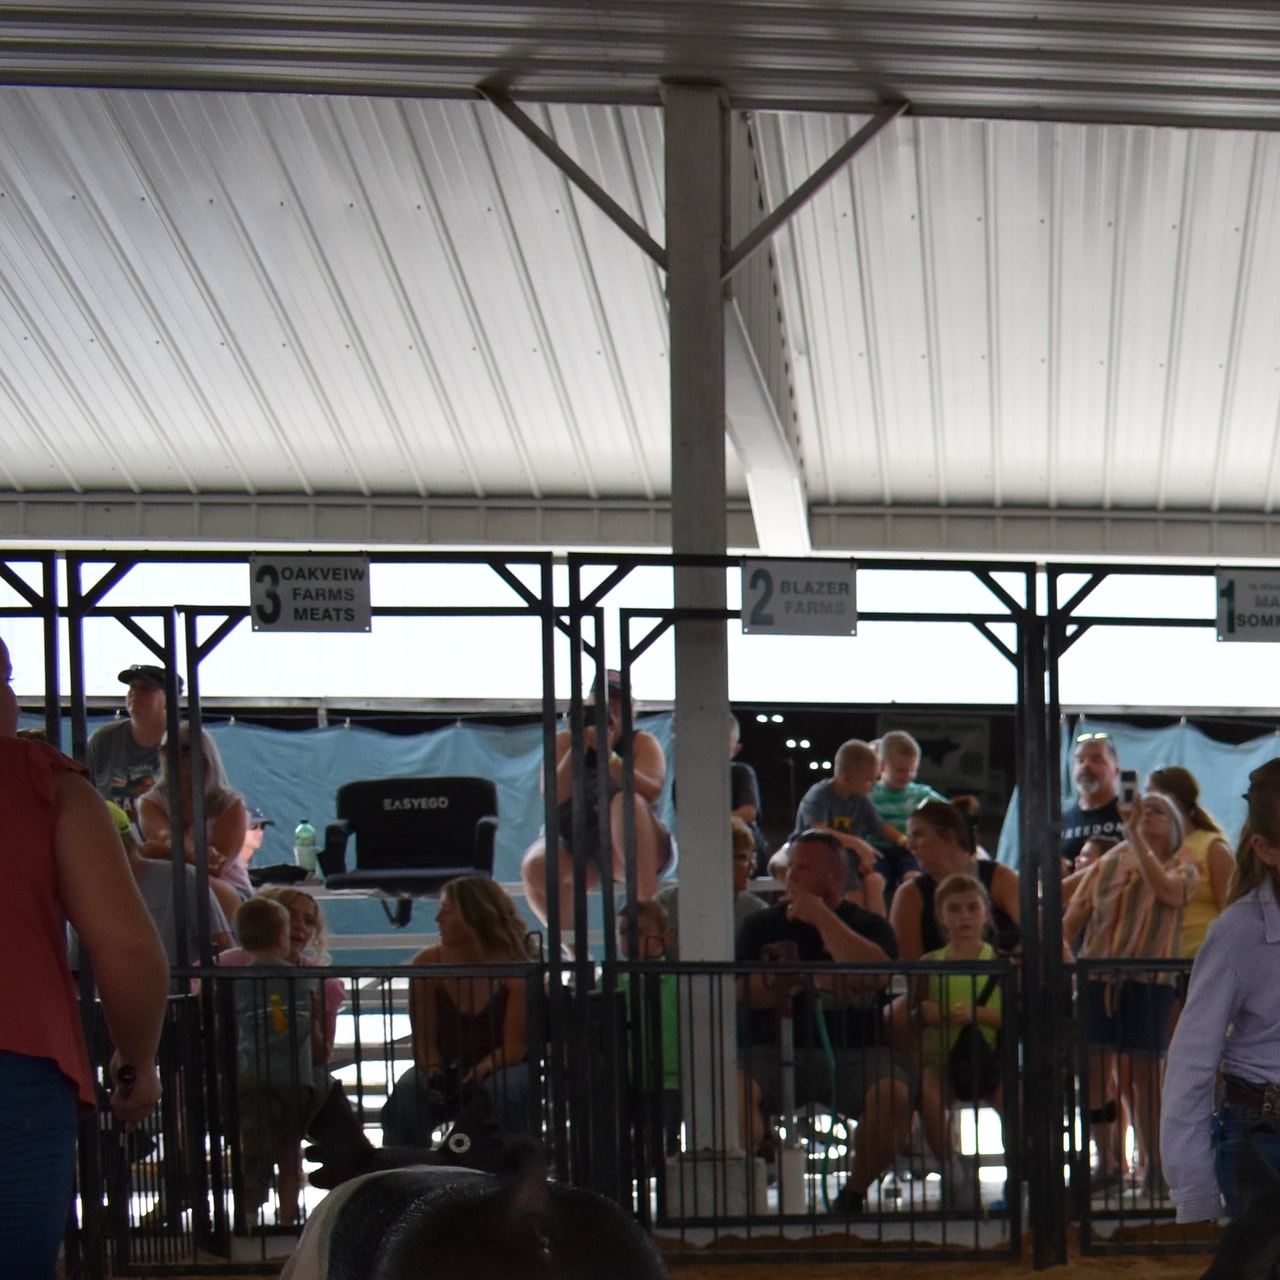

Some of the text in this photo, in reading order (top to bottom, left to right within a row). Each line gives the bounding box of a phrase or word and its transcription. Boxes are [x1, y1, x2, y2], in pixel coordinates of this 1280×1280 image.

[280, 566, 364, 581] OAKVEIW
[255, 564, 281, 624] 3
[292, 588, 355, 601] FARMS
[780, 581, 849, 596] BLAZER
[749, 568, 773, 626] 2
[785, 601, 846, 615] FARMS
[1220, 579, 1235, 633] 1
[293, 607, 355, 622] MEATS
[382, 796, 449, 811] EASYEGO
